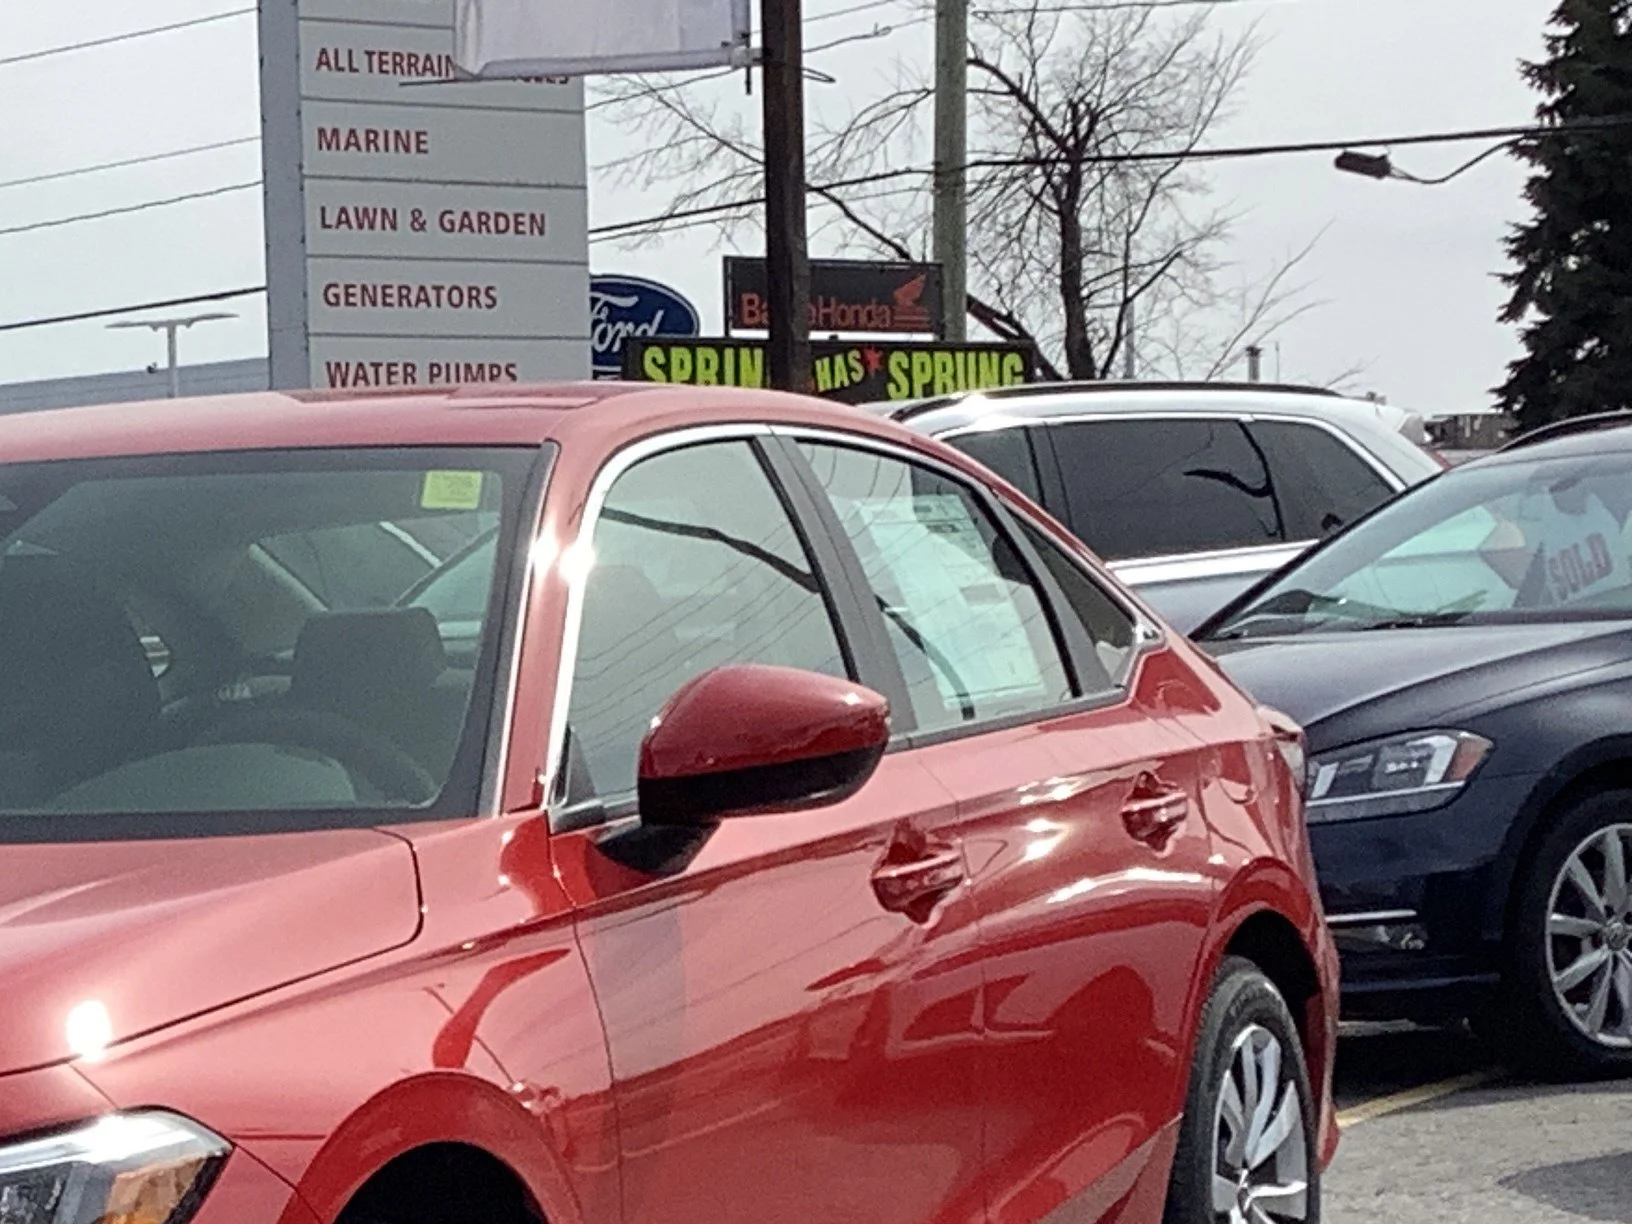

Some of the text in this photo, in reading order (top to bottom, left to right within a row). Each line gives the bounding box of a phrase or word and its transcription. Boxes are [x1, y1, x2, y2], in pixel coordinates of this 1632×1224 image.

[316, 48, 359, 73] ALL
[318, 127, 429, 154] MARINE
[320, 206, 546, 237] LAWN & GARDEN
[323, 283, 498, 309] GENERATORS
[325, 361, 418, 388] WATER
[815, 349, 865, 392] HAS
